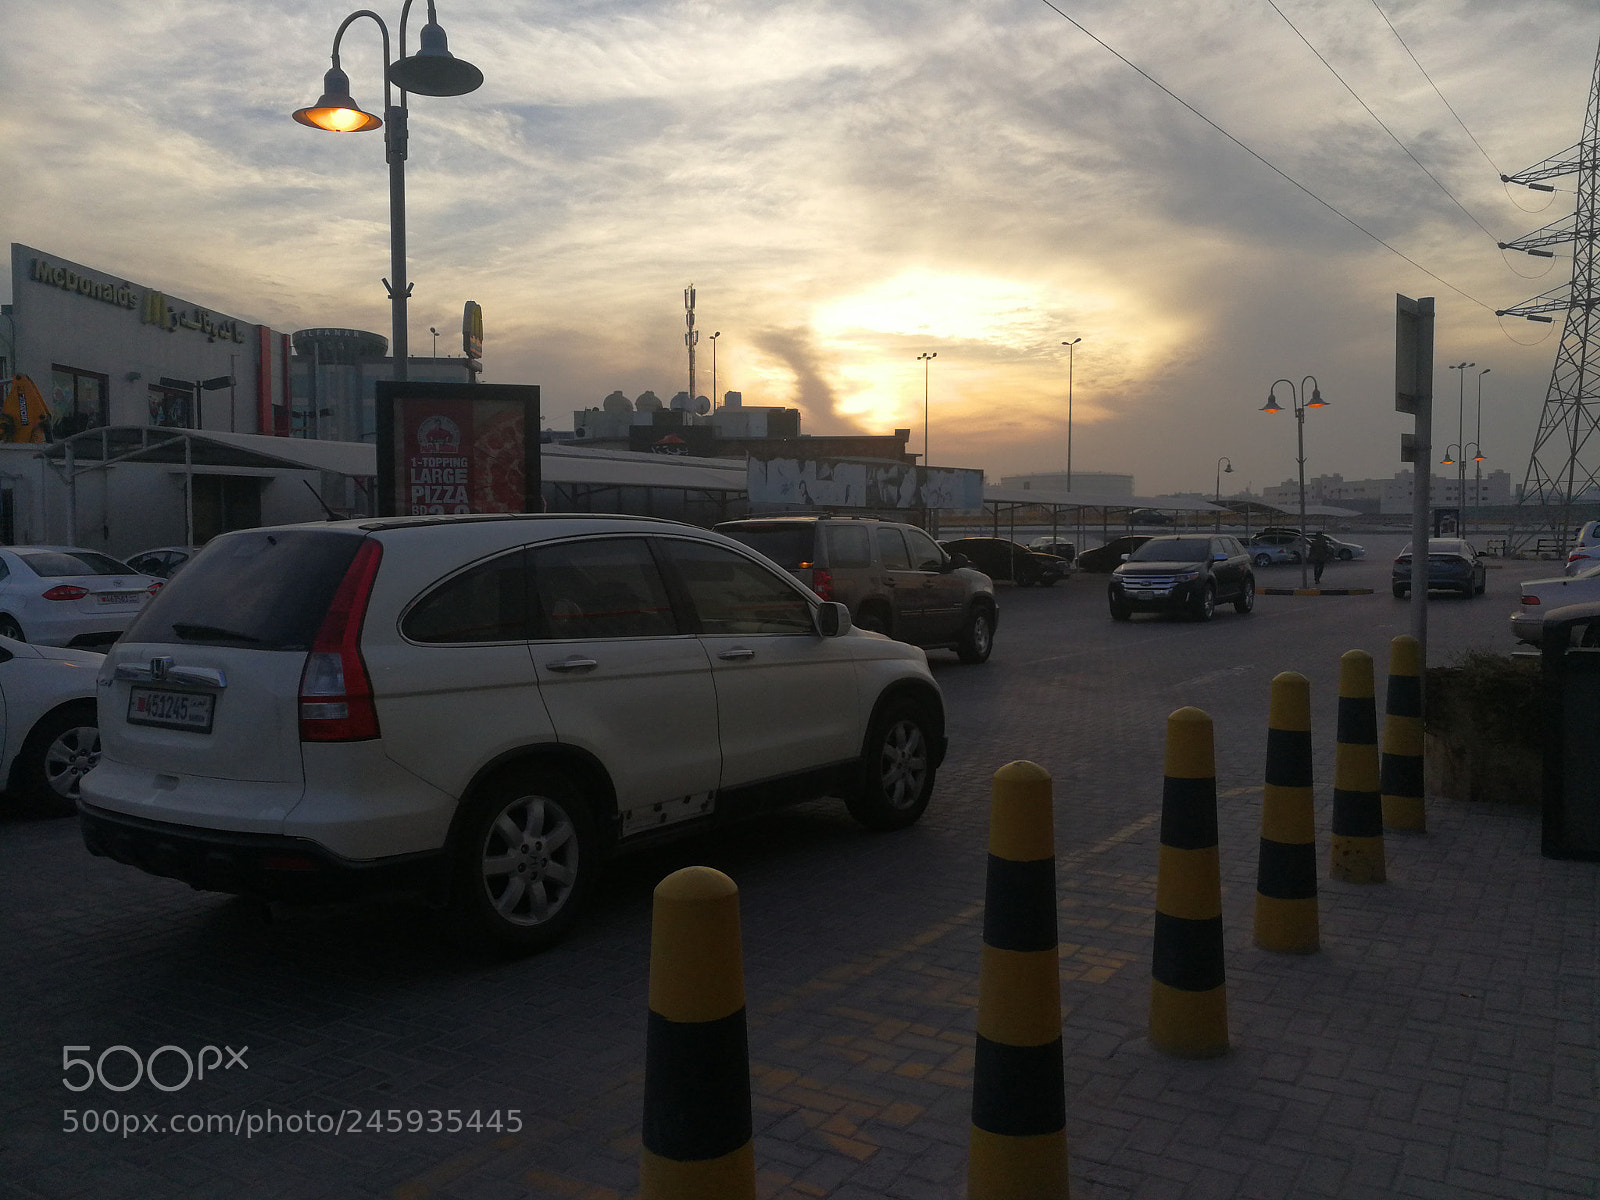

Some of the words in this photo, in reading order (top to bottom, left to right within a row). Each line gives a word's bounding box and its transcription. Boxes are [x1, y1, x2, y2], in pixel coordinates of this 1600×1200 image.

[32, 257, 137, 309] McDonald's
[410, 457, 468, 468] 1-TOPPING
[410, 468, 468, 484] LARGE
[411, 485, 469, 504] PIZZA
[145, 693, 188, 720] 451245
